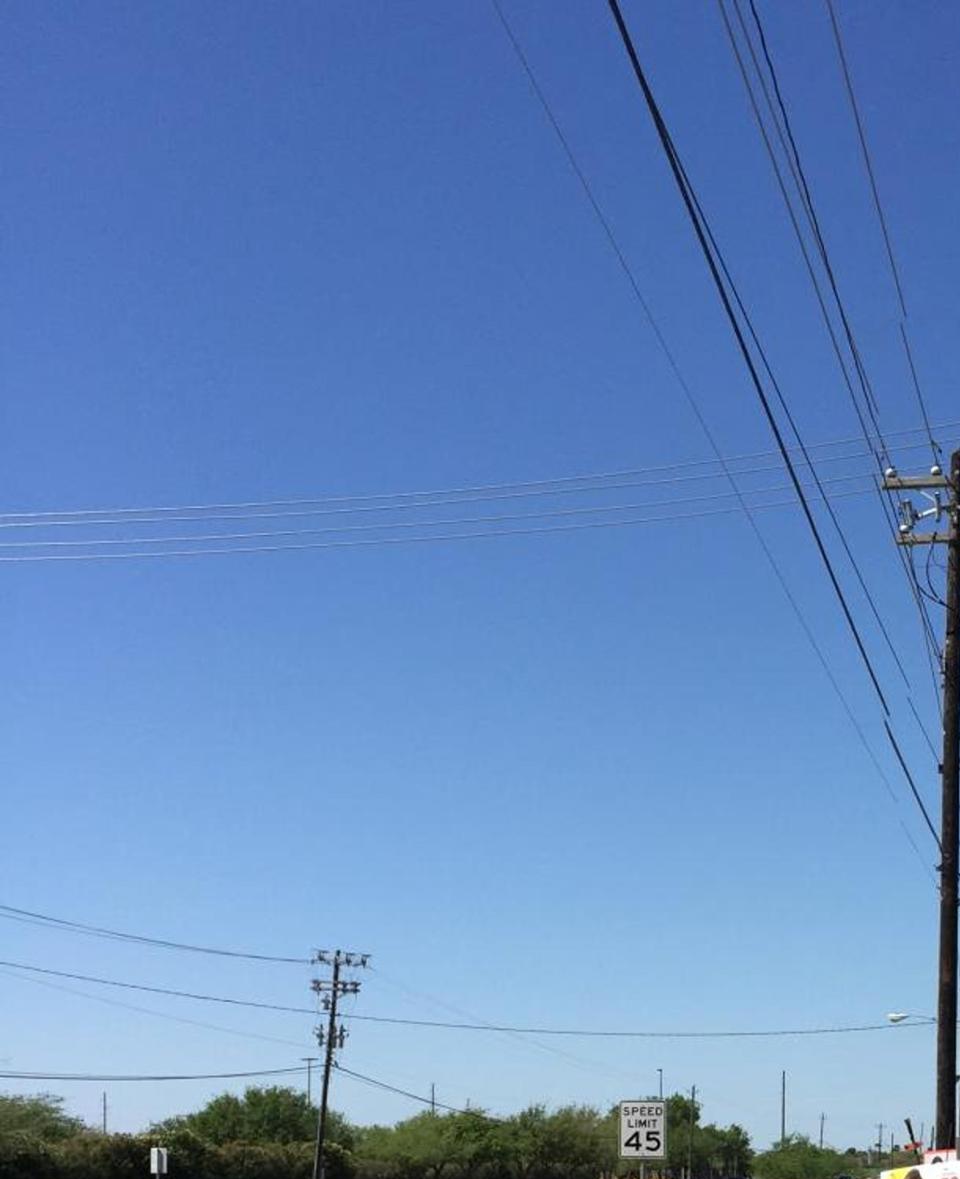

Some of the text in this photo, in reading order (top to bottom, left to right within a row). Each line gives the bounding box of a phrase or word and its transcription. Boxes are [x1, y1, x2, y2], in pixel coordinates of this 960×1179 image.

[623, 1106, 663, 1116] SPEED
[627, 1119, 657, 1129] LIMIT
[624, 1131, 661, 1152] 45
